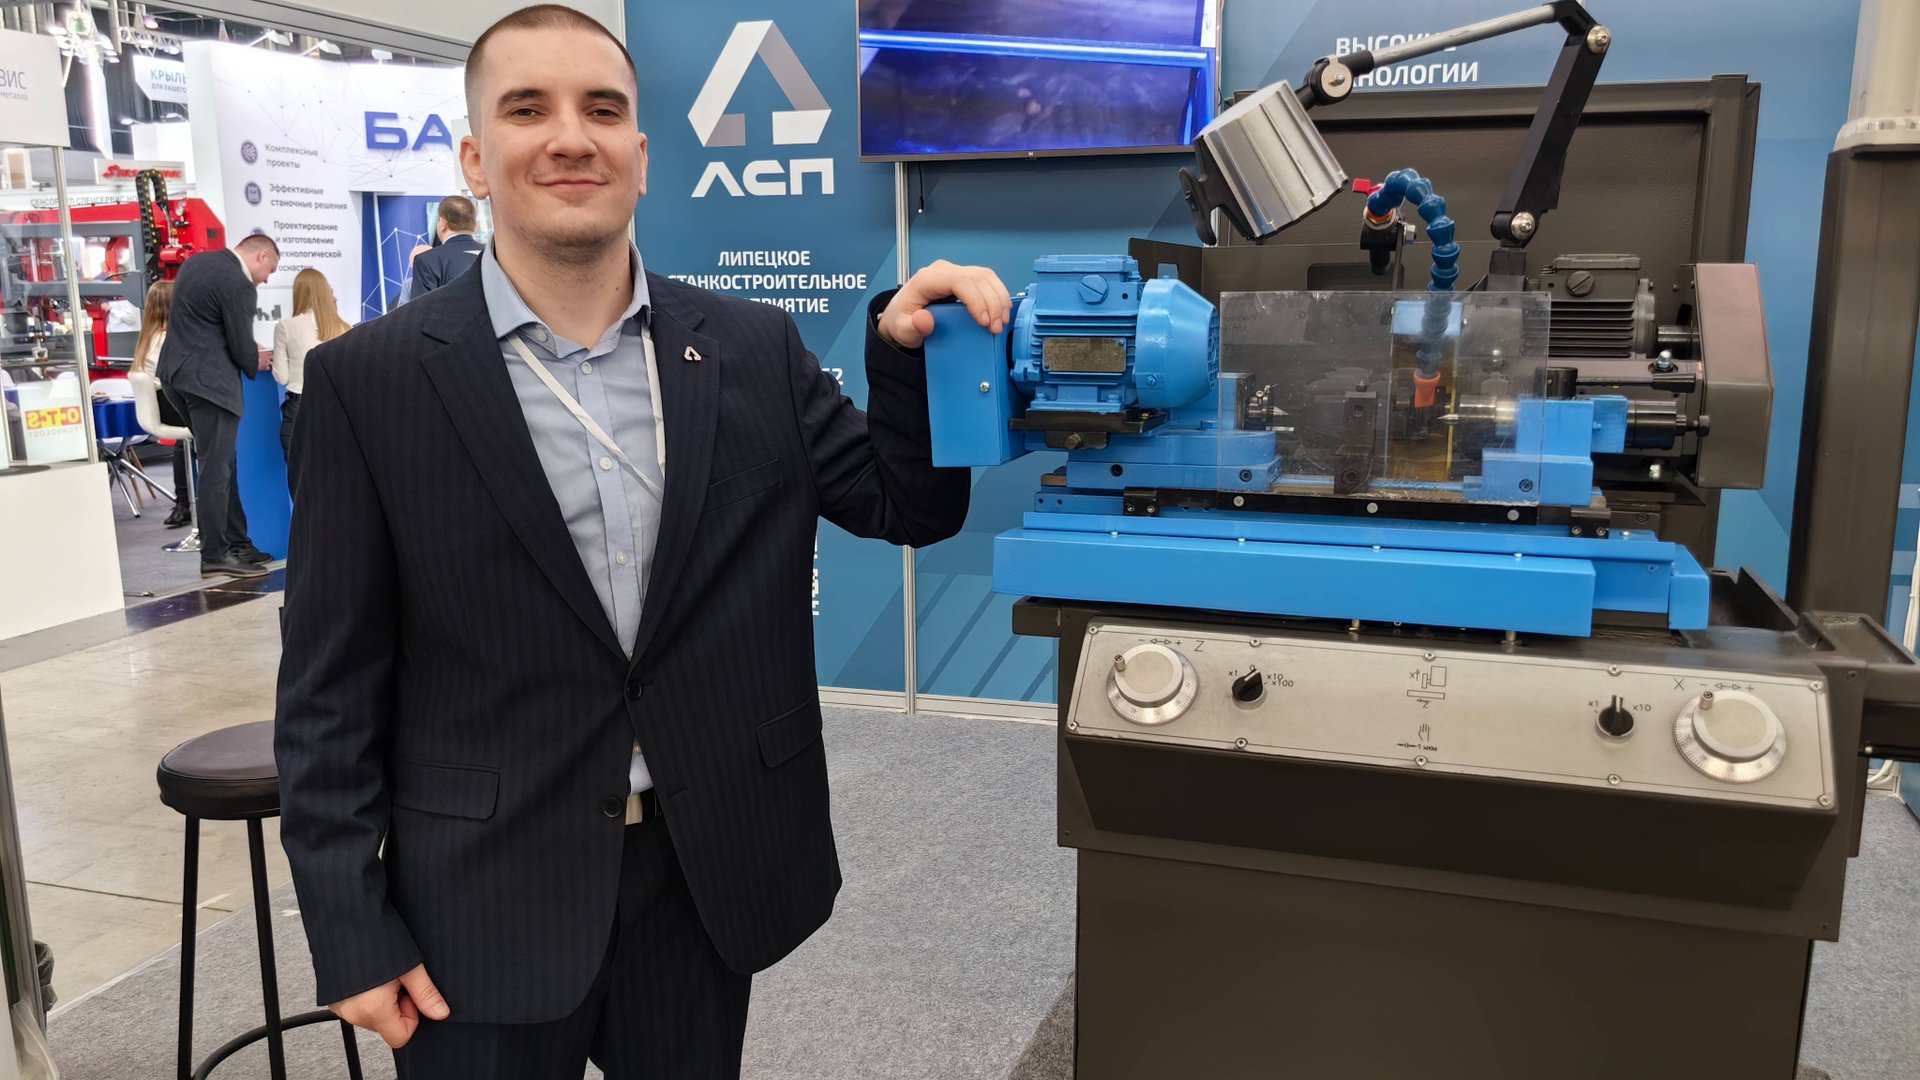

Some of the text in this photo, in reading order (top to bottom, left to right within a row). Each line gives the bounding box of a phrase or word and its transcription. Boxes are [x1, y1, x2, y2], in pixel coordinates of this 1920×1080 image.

[1336, 32, 1456, 57] ВЫСО
[1353, 61, 1479, 87] НОЛОГИИ
[265, 143, 319, 157] Комплексные
[266, 159, 301, 169] проекты
[269, 183, 324, 195] Эффективные
[270, 199, 348, 210] станочные решения
[273, 220, 338, 231] Проектирование
[280, 249, 342, 258] ехнологической
[717, 250, 811, 269] ЛИПЕЦКОЕ
[667, 273, 867, 290] ТАНКОСТРОИТЕЛЬНОЕ
